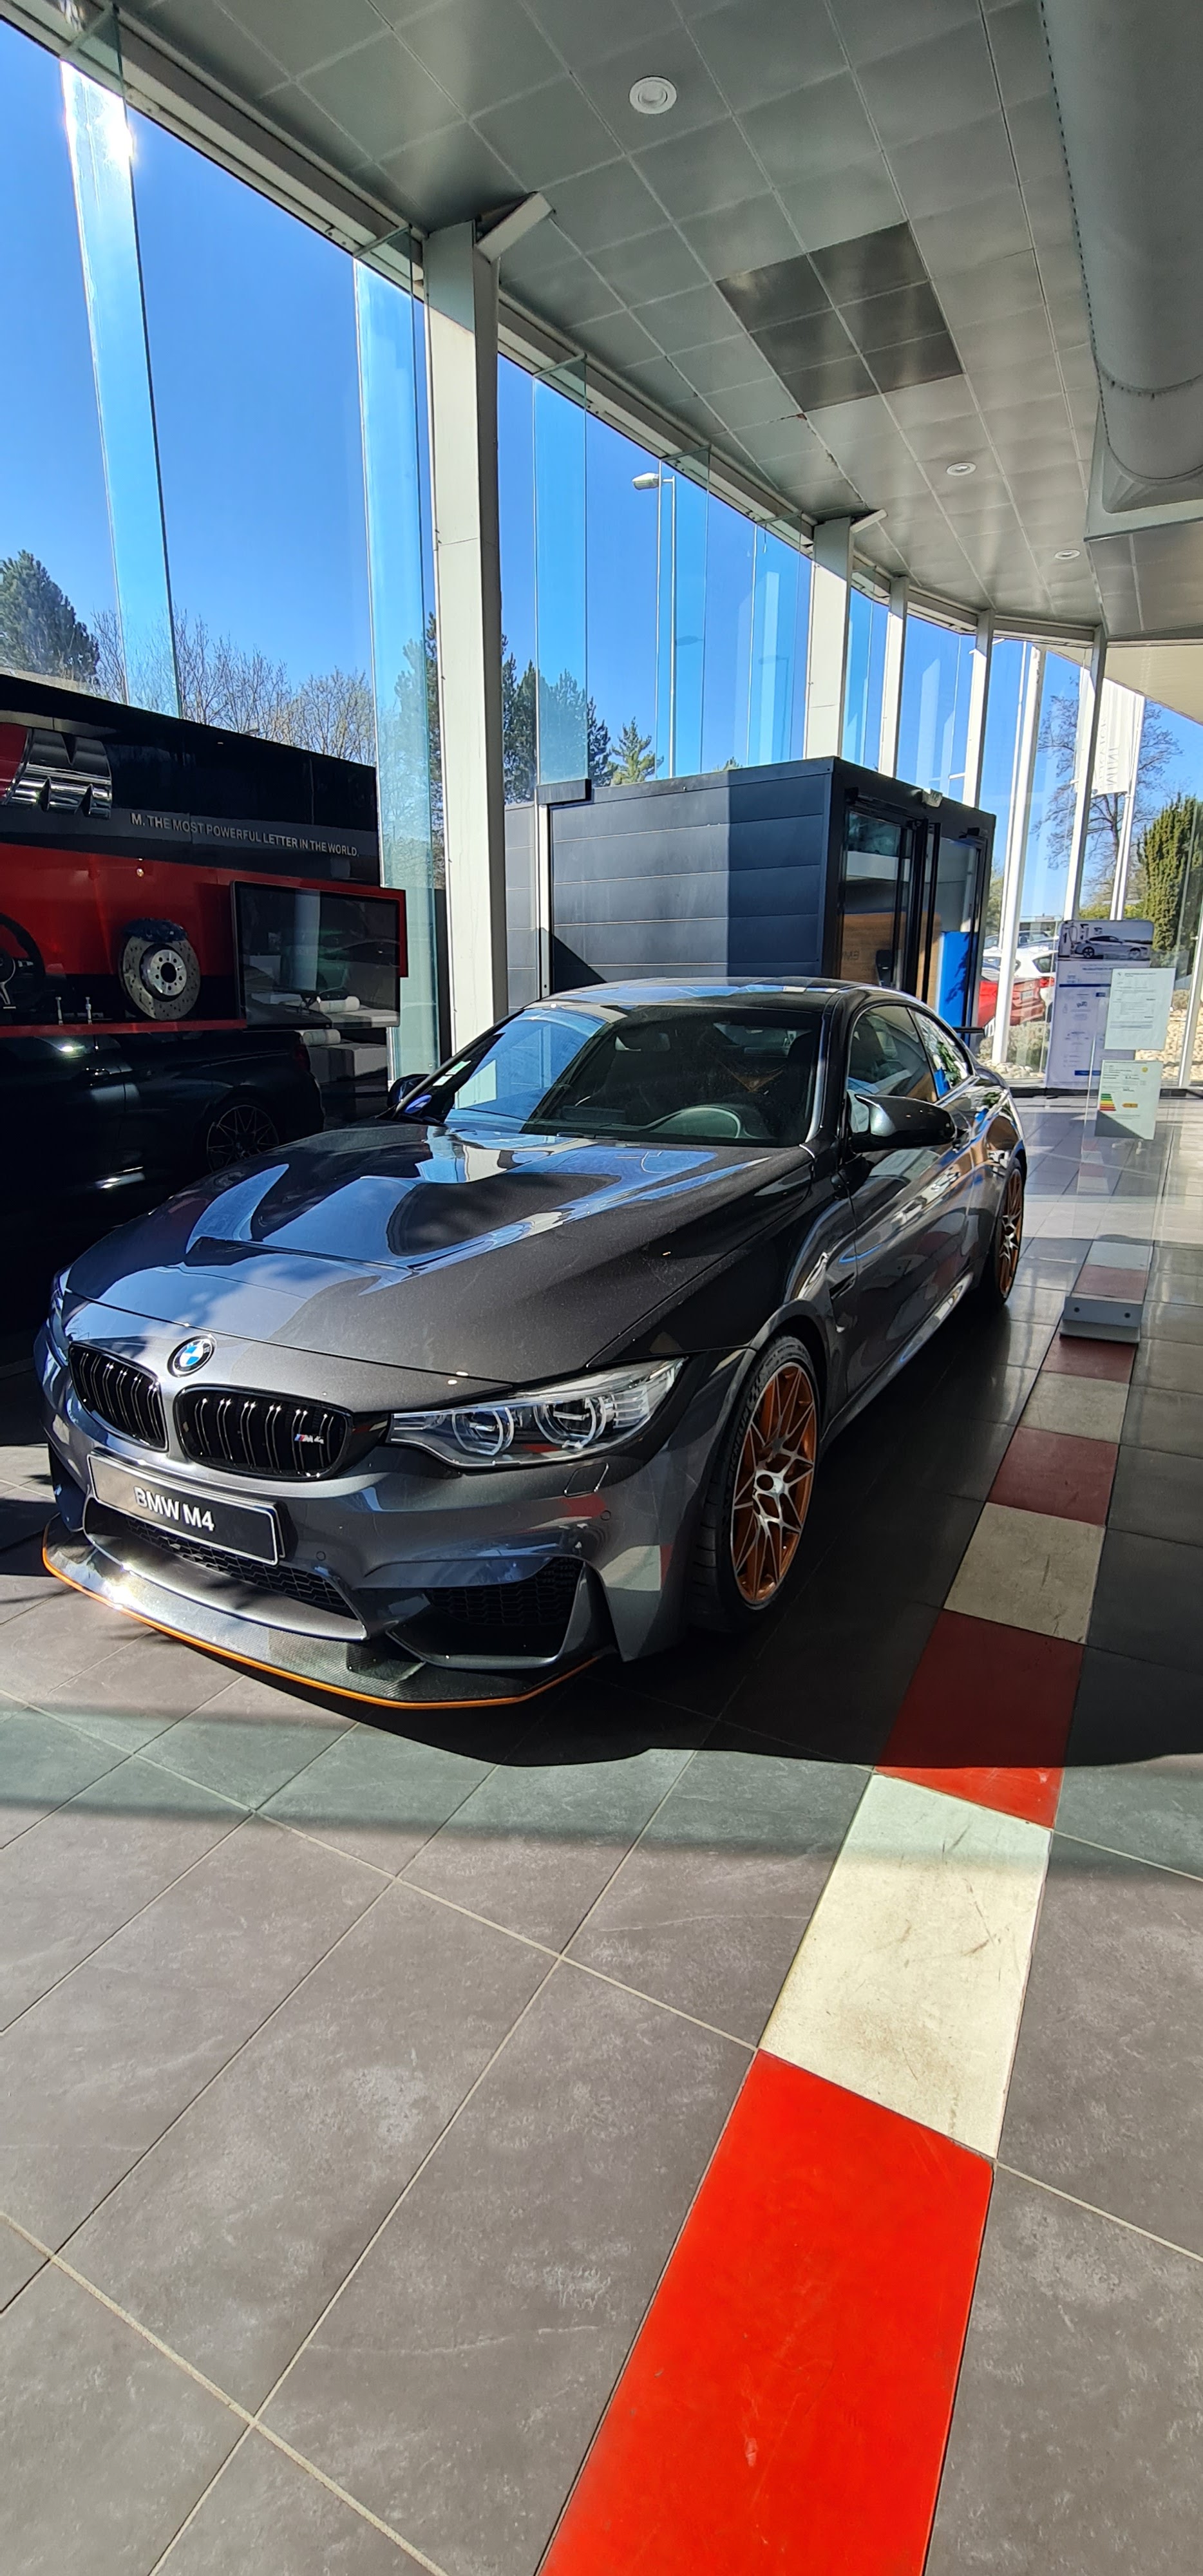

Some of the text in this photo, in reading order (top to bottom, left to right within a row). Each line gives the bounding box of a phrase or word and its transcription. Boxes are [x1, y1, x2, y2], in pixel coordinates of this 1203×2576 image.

[131, 813, 359, 857] M. THE MOST POWERFUL LETTER IN THE WORLD.
[133, 1486, 215, 1531] BMW M4
